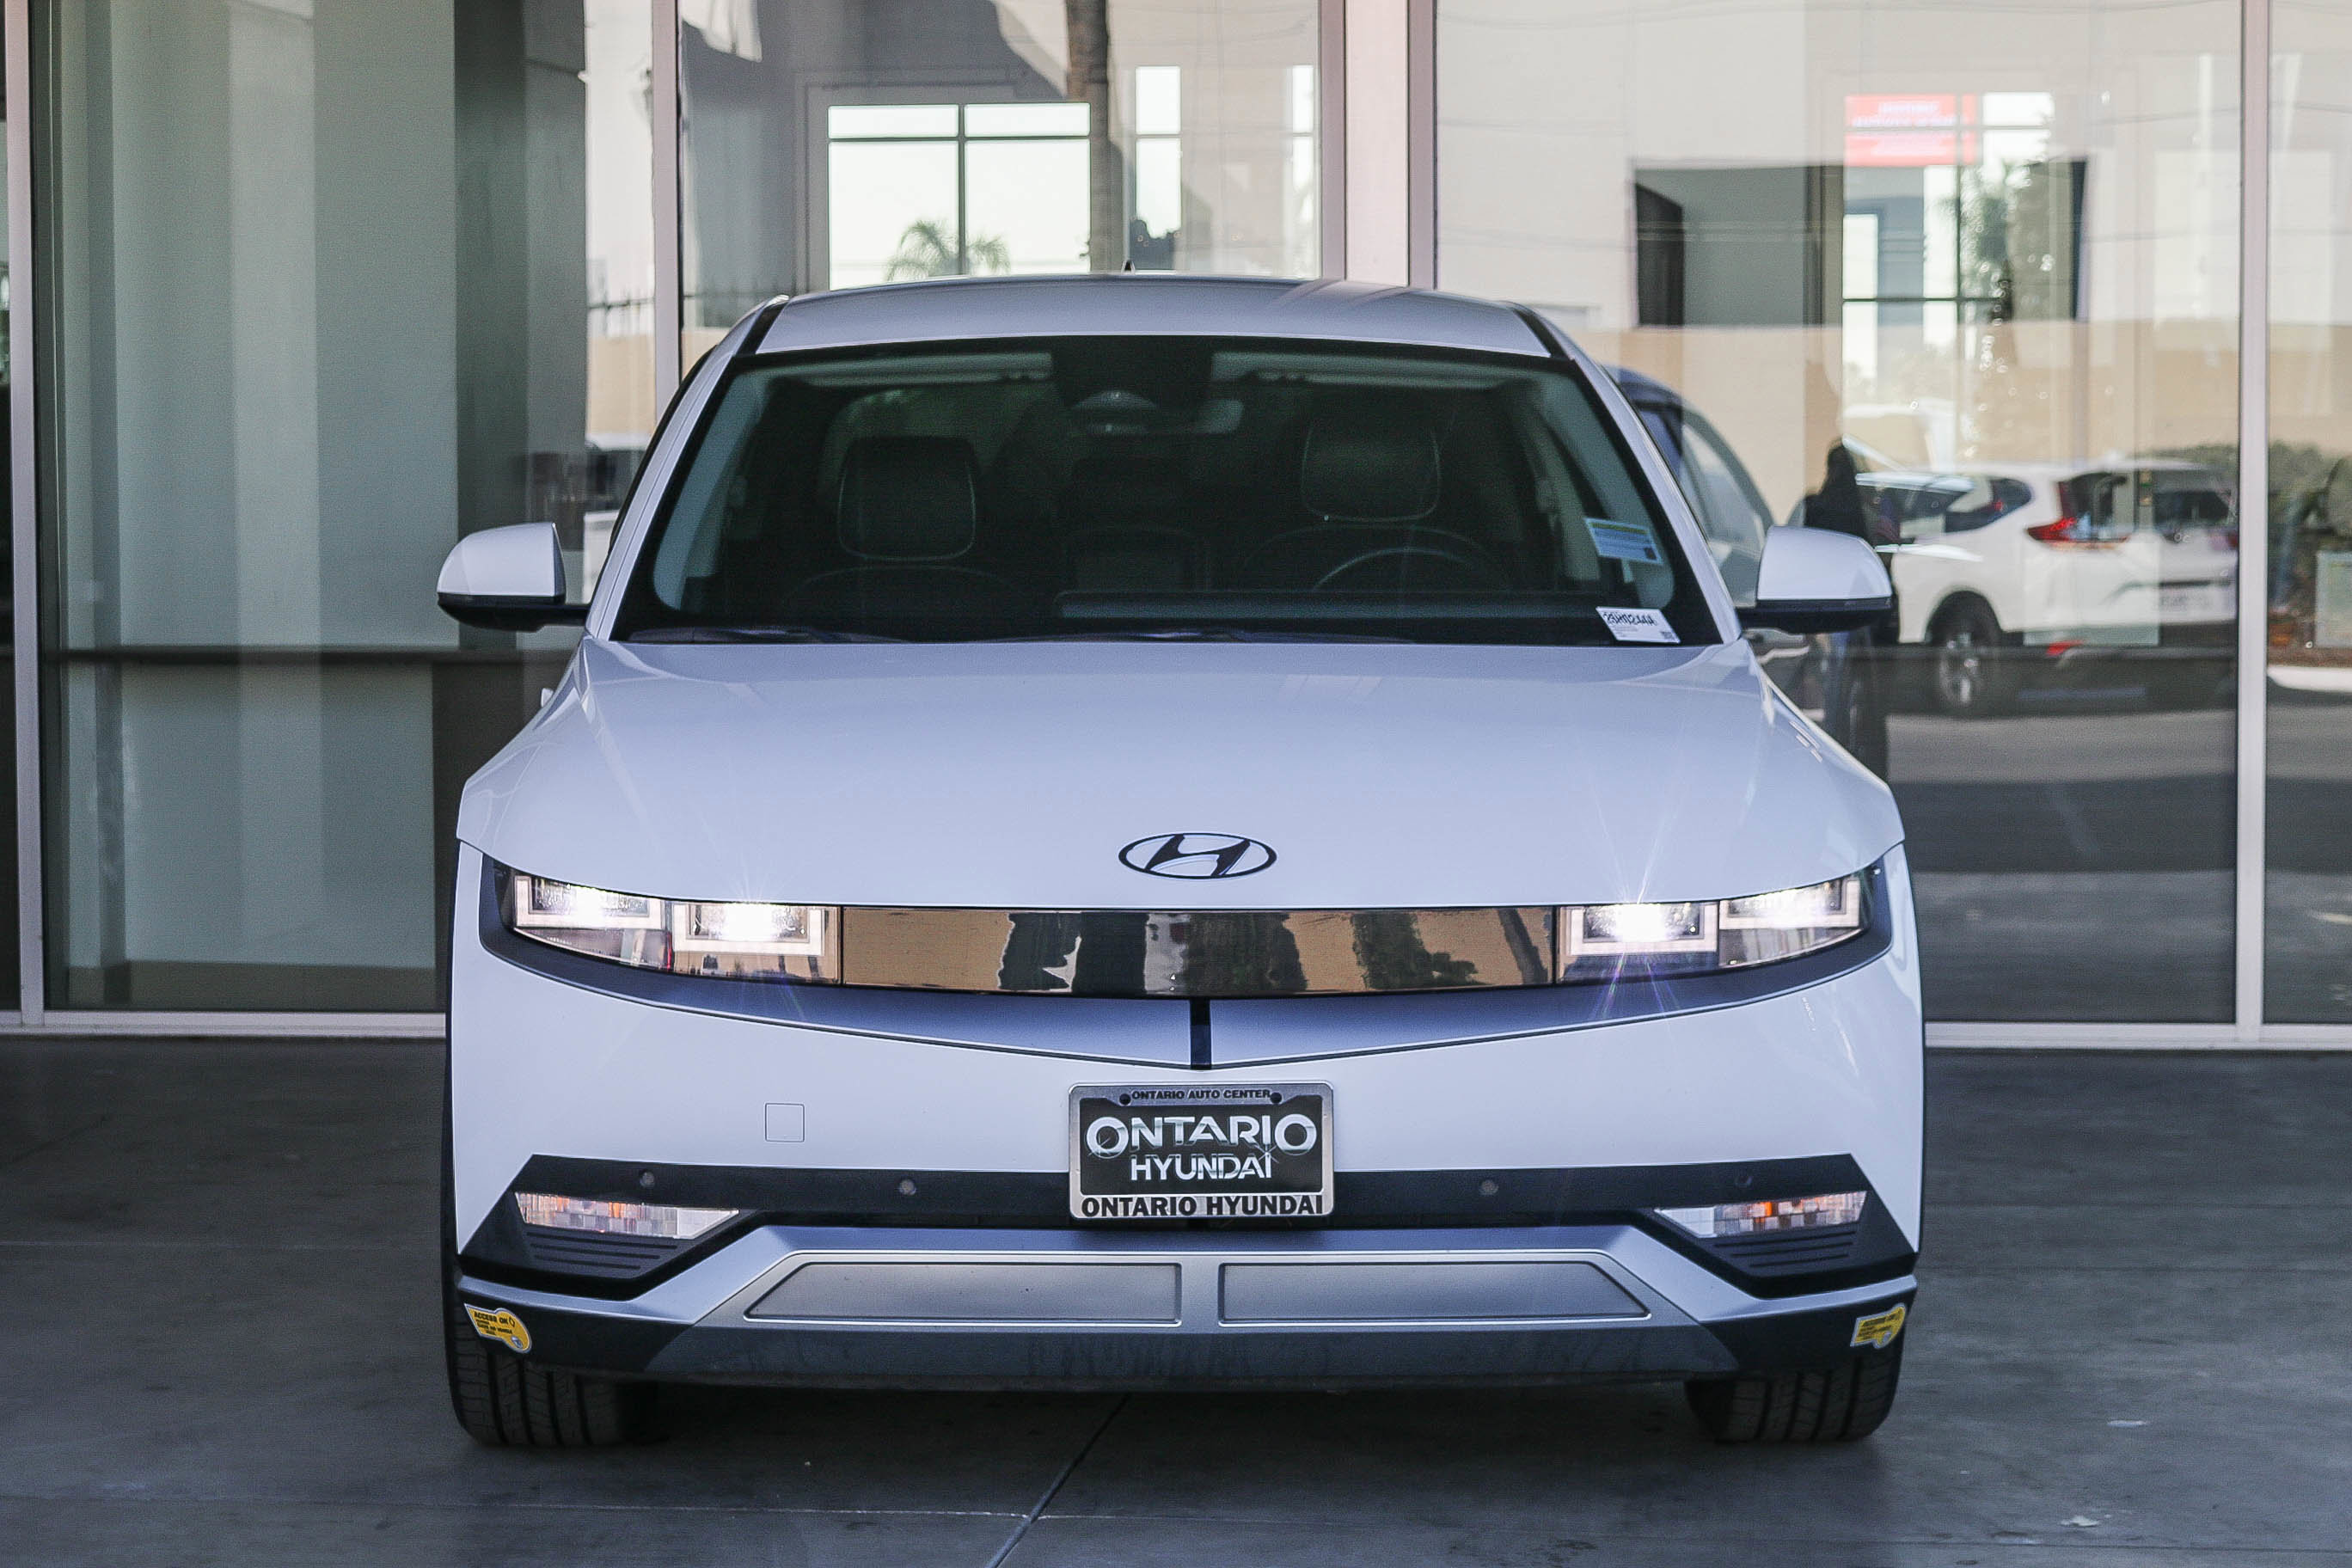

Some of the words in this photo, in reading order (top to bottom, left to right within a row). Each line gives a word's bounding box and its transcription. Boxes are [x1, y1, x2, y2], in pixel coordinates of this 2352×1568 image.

[1131, 1090, 1185, 1100] ONTARIO
[1188, 1090, 1221, 1099] AUTO
[1223, 1089, 1271, 1099] CENTER
[1087, 1114, 1317, 1158] ONTARIO
[1130, 1154, 1271, 1181] HYUNDAI
[1081, 1196, 1197, 1216] ONTARIO
[1206, 1195, 1323, 1216] HYUNDAI
